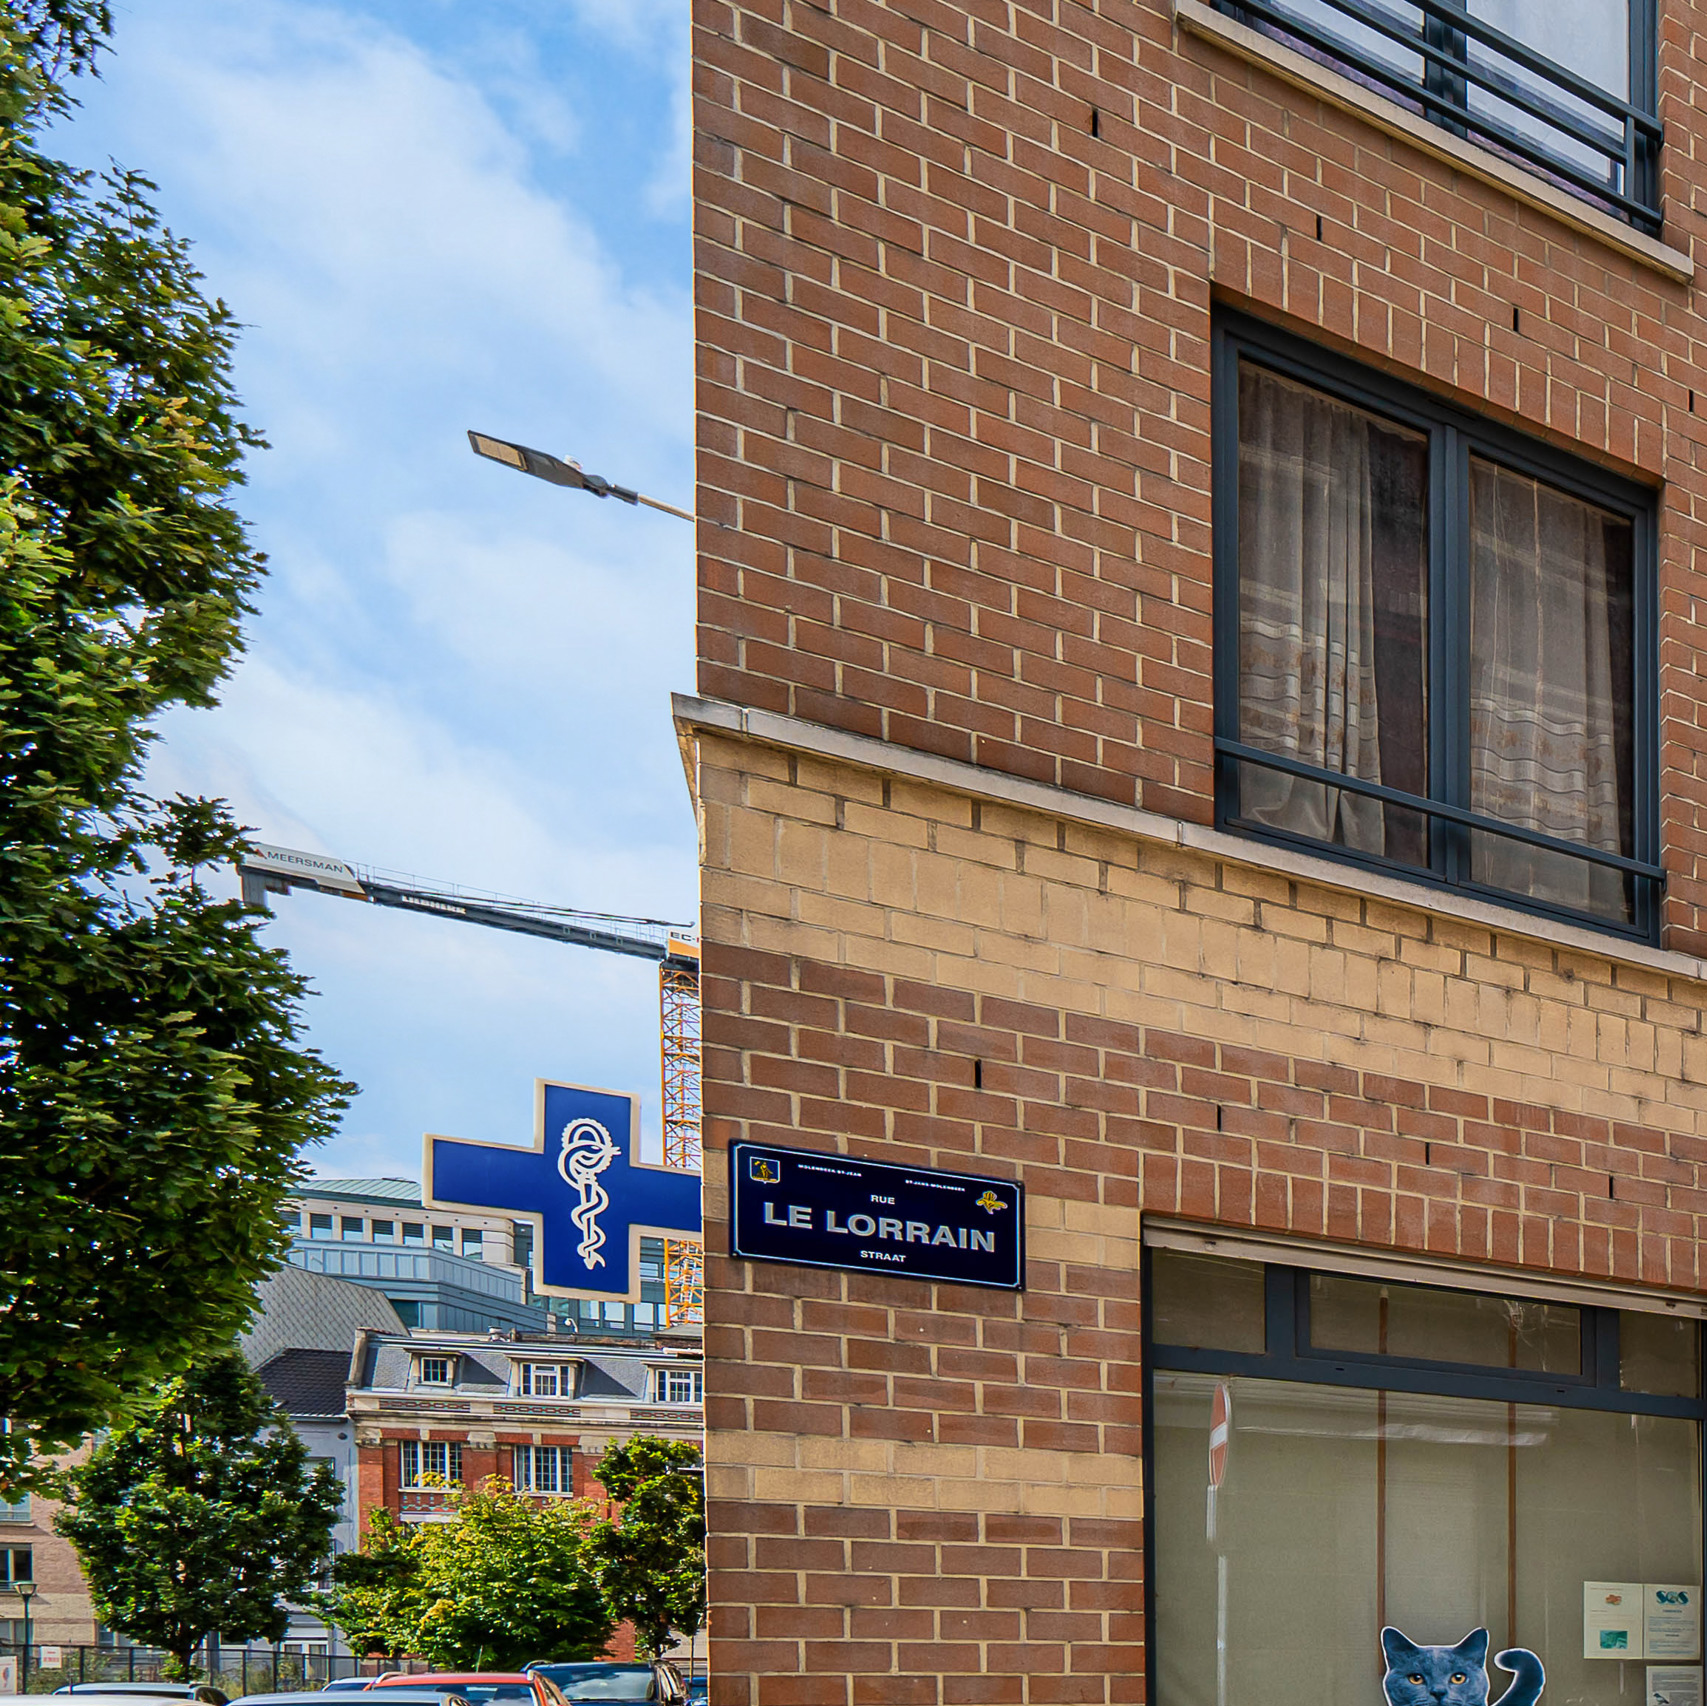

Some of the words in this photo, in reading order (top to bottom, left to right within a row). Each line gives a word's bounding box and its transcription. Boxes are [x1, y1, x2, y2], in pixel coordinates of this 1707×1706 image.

[870, 1194, 895, 1205] RUE
[763, 1201, 813, 1230] LE
[826, 1210, 995, 1253] LORRAIN
[860, 1250, 906, 1263] STRAAT
